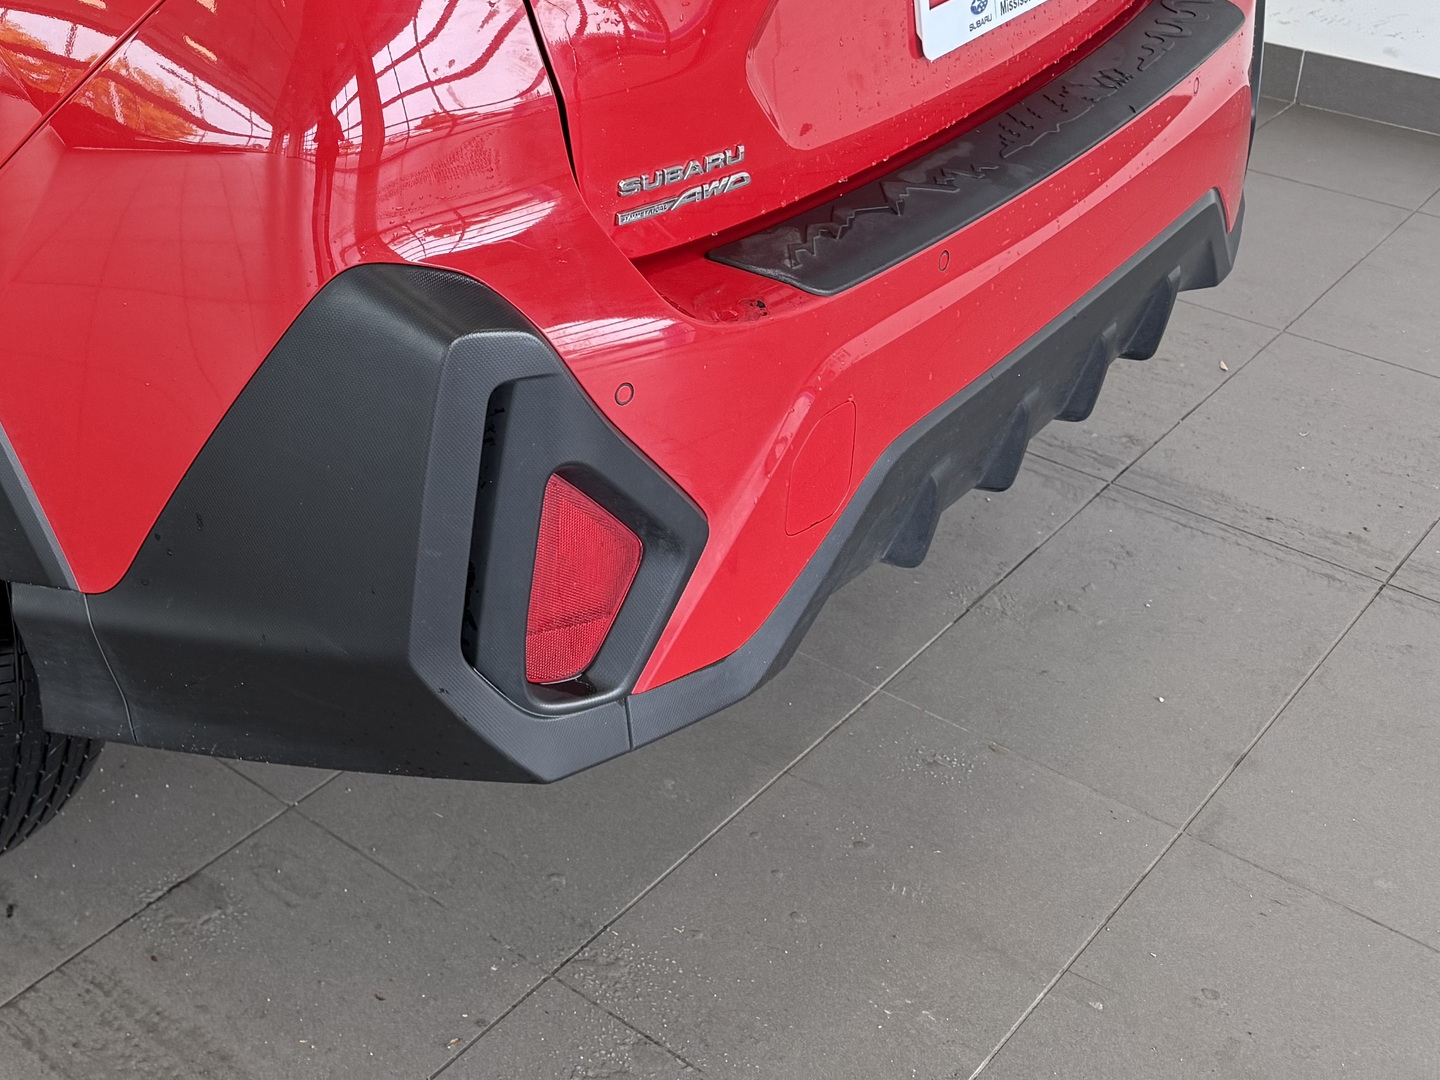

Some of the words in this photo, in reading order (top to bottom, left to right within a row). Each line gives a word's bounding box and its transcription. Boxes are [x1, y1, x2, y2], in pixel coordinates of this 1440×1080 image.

[969, 13, 993, 32] SUBARU
[618, 145, 745, 197] SUBARU
[671, 172, 751, 210] AWD
